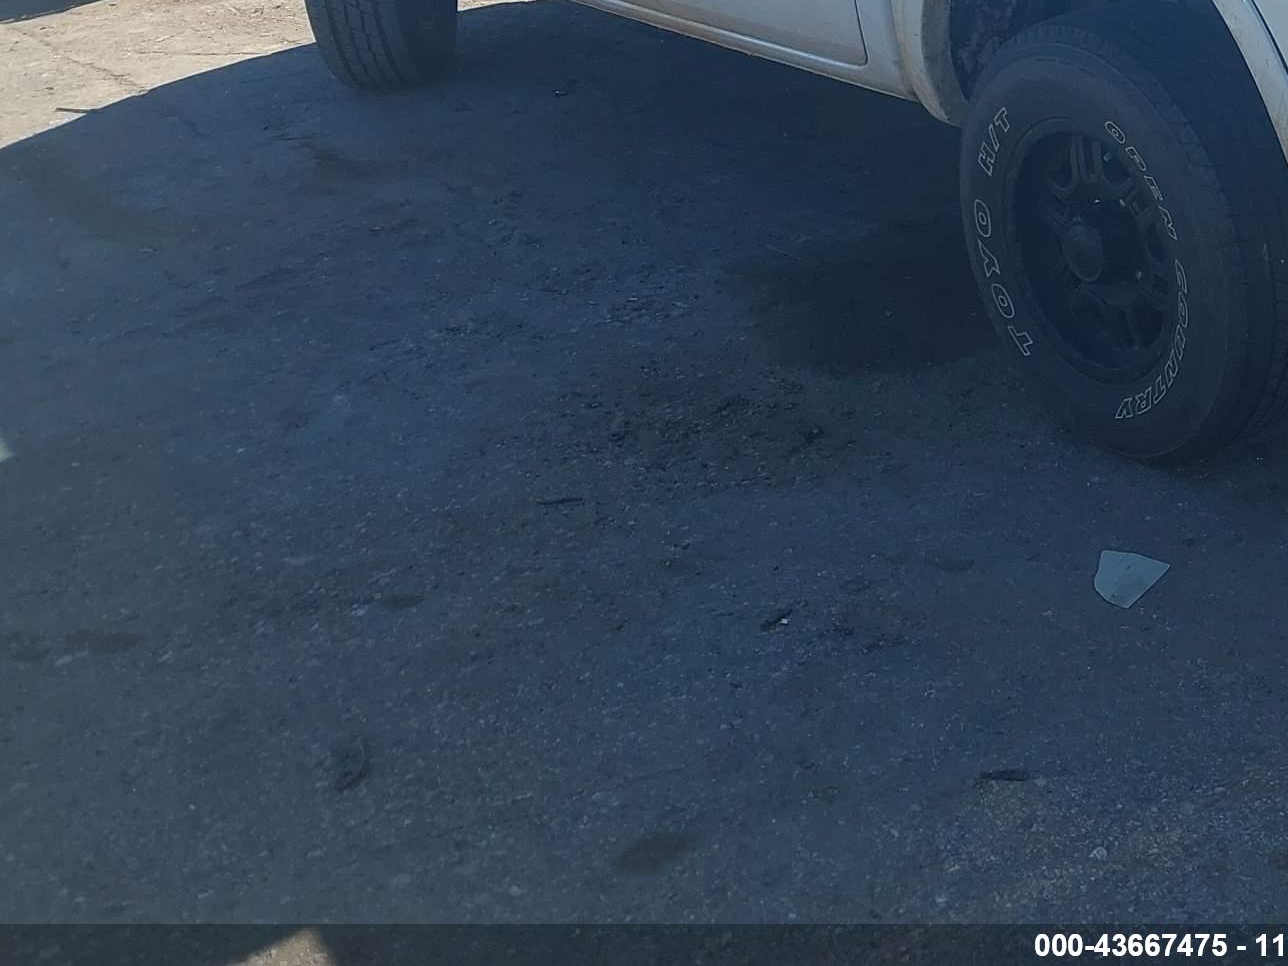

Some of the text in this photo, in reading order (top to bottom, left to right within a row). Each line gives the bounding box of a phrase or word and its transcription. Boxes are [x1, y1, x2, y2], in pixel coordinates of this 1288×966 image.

[1104, 120, 1179, 241] OPEN
[974, 199, 1034, 357] TOYO
[1114, 258, 1190, 420] COUNTRY
